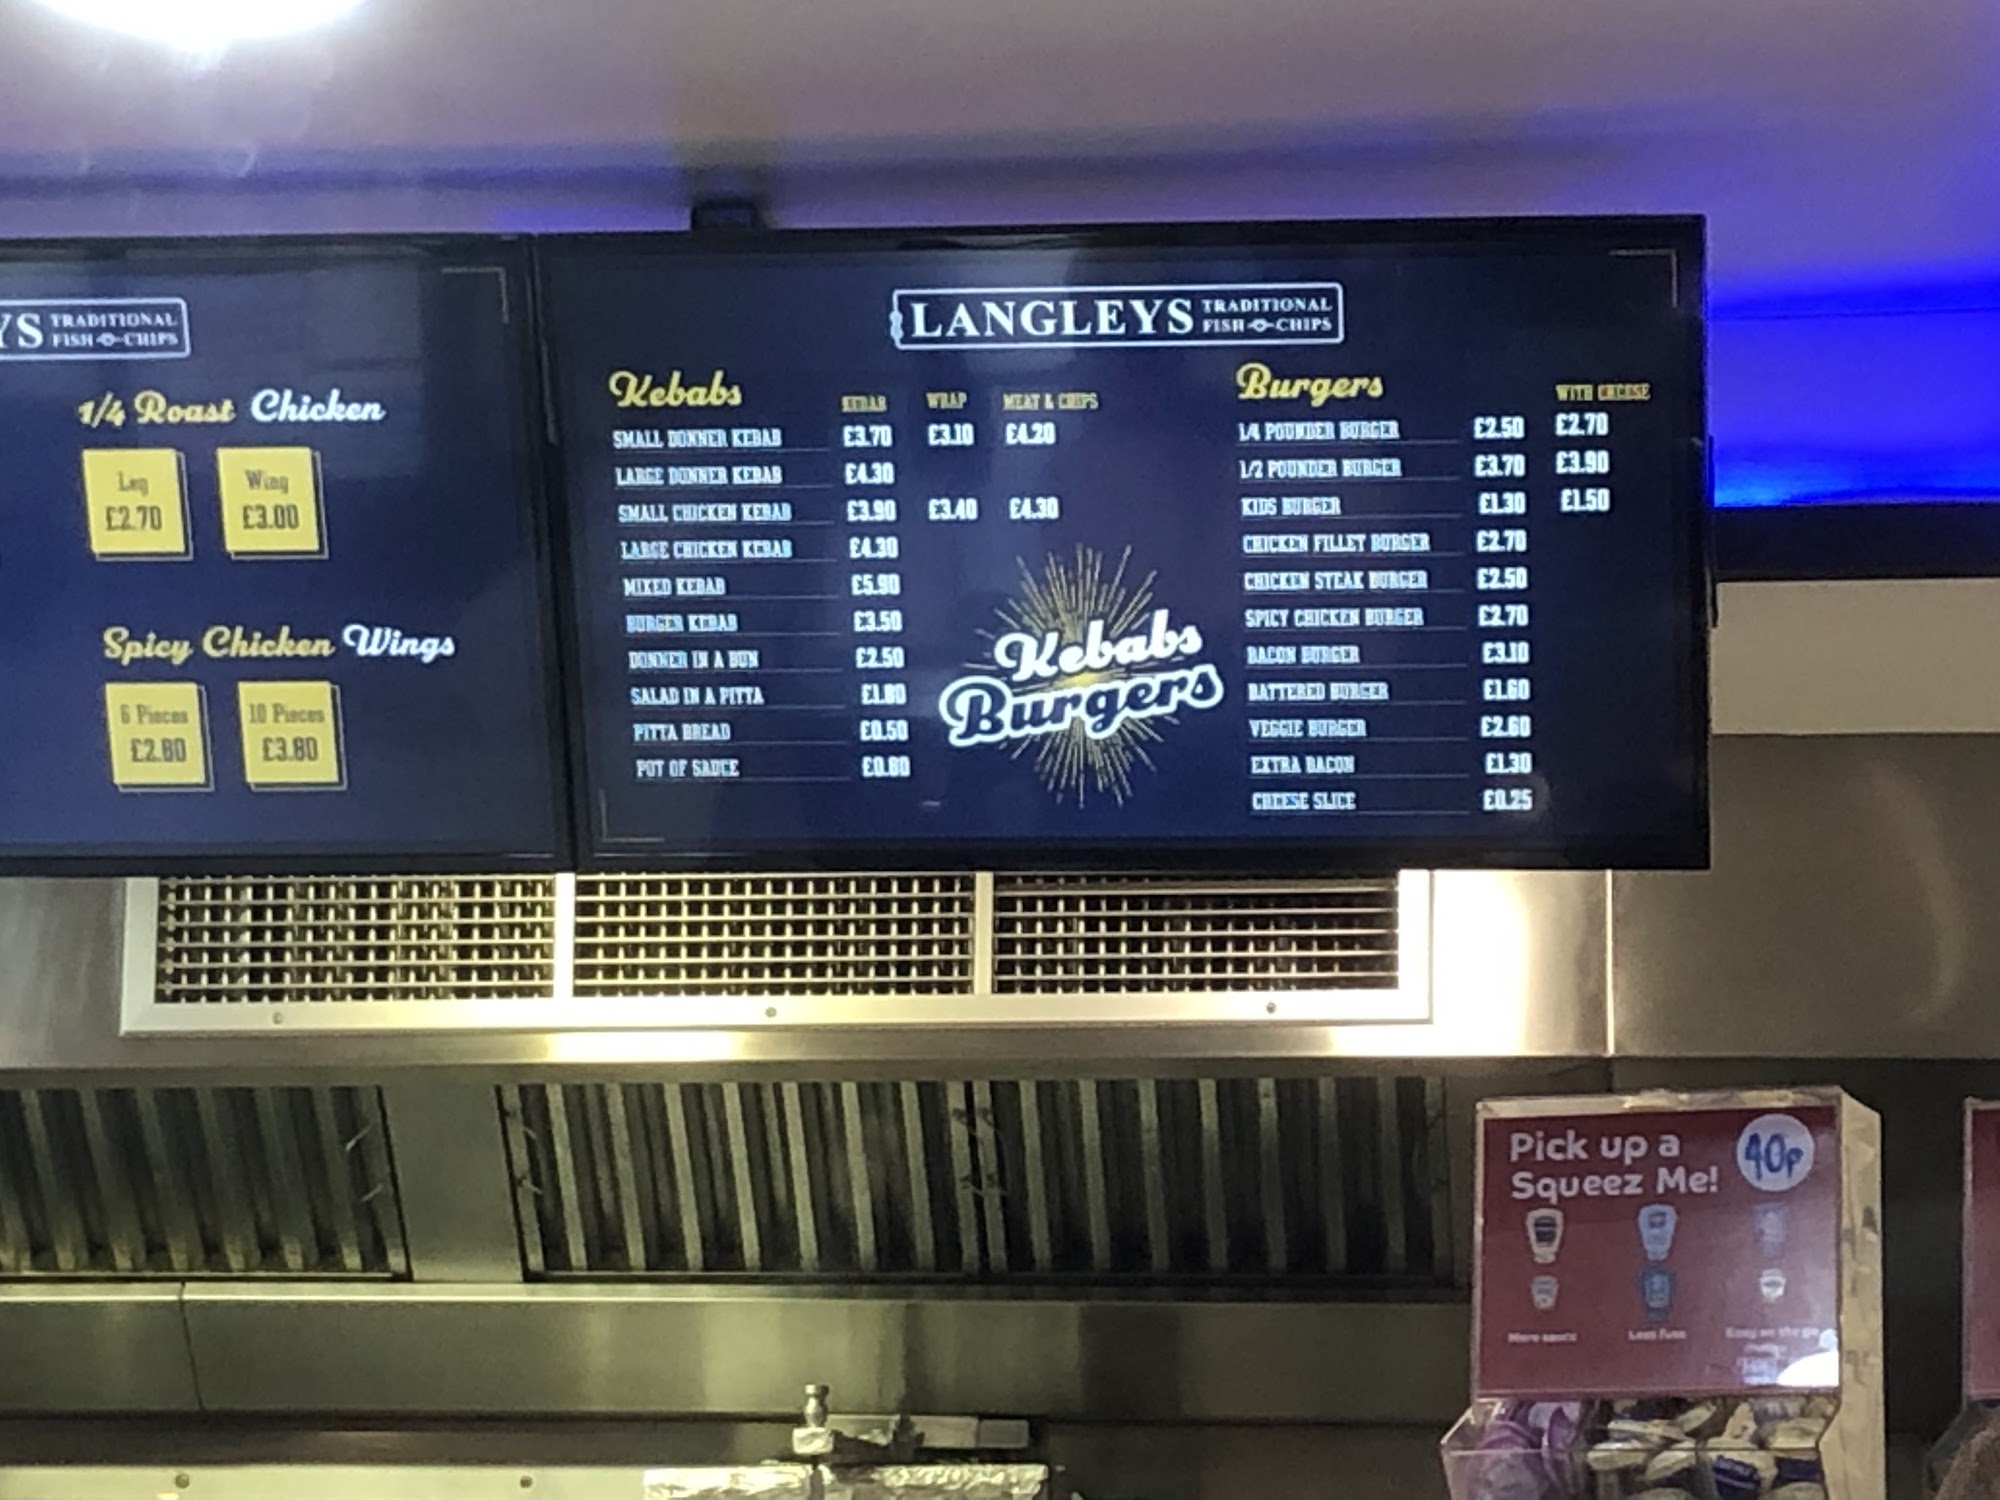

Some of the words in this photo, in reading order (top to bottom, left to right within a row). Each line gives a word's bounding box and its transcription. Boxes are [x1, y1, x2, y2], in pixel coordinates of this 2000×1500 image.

[1202, 297, 1333, 313] TRADITIONAL
[50, 311, 178, 328] TRADITIONAL
[911, 298, 1194, 338] LANGLEYS
[1202, 319, 1244, 333] FISH
[1275, 316, 1331, 331] CHIPS
[53, 332, 93, 348] FISH
[124, 331, 178, 347] CHIPS
[609, 369, 742, 408] Kebabs
[1236, 362, 1384, 407] Burgers
[1555, 384, 1593, 401] WITH
[78, 391, 126, 429] 1/4
[133, 390, 235, 424] Roast
[251, 388, 386, 422] Chicken
[926, 392, 967, 409] WRAP
[1003, 393, 1040, 411] MEAT
[1044, 393, 1054, 410] &
[1058, 392, 1099, 410] CHIPS
[613, 430, 664, 448] SMALL
[667, 430, 728, 448] DONNER
[731, 428, 782, 447] KEBAB
[843, 425, 892, 447] £3.70
[928, 423, 975, 446] £3.10
[1005, 422, 1055, 445] £4.20
[1238, 423, 1261, 441] 1/4
[1265, 422, 1335, 441] POUNDER
[1339, 421, 1399, 440] BURGER
[1473, 416, 1525, 439] £2.50
[1556, 412, 1608, 436] £2.70
[615, 467, 664, 486] LARGE
[669, 467, 728, 485] DONNER
[732, 466, 782, 485] KEBAB
[845, 462, 895, 484] £4.30
[1239, 459, 1263, 478] 1/2
[1267, 459, 1338, 478] POUNDER
[1342, 458, 1402, 477] BURGER
[1474, 454, 1526, 478] £3.70
[1556, 450, 1609, 474] £3.90
[118, 471, 149, 496] Leg
[244, 469, 289, 494] Wing
[618, 503, 668, 523] SMALL
[672, 503, 737, 522] CHICKEN
[741, 502, 792, 521] KEBAB
[847, 499, 897, 522] £3.90
[929, 498, 978, 520] £3.40
[1009, 497, 1059, 520] £4.30
[1241, 498, 1277, 516] KIDS
[1281, 497, 1342, 515] BURGER
[1479, 491, 1526, 515] £1.30
[1561, 488, 1611, 512] £1.50
[105, 506, 162, 531] £2.70
[243, 504, 300, 529] £3.00
[620, 541, 669, 560] LARGE
[673, 540, 737, 558] CHICKEN
[742, 540, 792, 558] KEBAB
[850, 536, 899, 558] £4.30
[1242, 534, 1308, 553] CHICKEN
[1313, 534, 1366, 552] FILLET
[1370, 533, 1430, 552] BURGER
[1476, 529, 1527, 553] £2.70
[623, 578, 672, 596] MIXED
[675, 577, 726, 596] KEBAB
[852, 573, 900, 596] £5.90
[1244, 572, 1309, 590] CHICKEN
[1315, 571, 1364, 590] STEAK
[1368, 570, 1428, 589] BURGER
[1476, 567, 1528, 590] £2.50
[626, 614, 684, 633] BURGER
[688, 614, 738, 632] KEBAB
[854, 610, 903, 632] £3.50
[1244, 609, 1289, 628] SPICY
[1293, 608, 1360, 627] CHICKEN
[1364, 607, 1424, 626] BURGER
[1478, 604, 1529, 627] £2.70
[103, 627, 193, 666] Spicy
[203, 625, 335, 658] Chicken
[342, 624, 455, 664] Wings
[994, 609, 1203, 682] Kebabs
[1246, 645, 1297, 664] BACON
[1301, 645, 1360, 664] BURGER
[1482, 641, 1530, 664] £3.10
[628, 651, 688, 669] DONNER
[692, 650, 709, 668] IN
[713, 650, 725, 668] A
[728, 650, 759, 668] BUN
[856, 647, 904, 669] £2.50
[631, 687, 680, 705] SALAD
[683, 687, 700, 705] IN
[704, 687, 716, 705] A
[719, 686, 765, 705] PITTA
[1248, 683, 1325, 701] BATTERED
[1329, 682, 1389, 701] BURGER
[1483, 678, 1531, 701] £1.60
[120, 705, 130, 724] 6
[137, 704, 188, 724] Pieces
[249, 703, 267, 723] 10
[273, 703, 325, 724] Pieces
[940, 664, 1224, 747] Burgers
[633, 724, 678, 742] PITTA
[682, 723, 731, 741] BREAD
[860, 720, 909, 741] £0.50
[1248, 719, 1303, 738] VEGGIE
[1307, 719, 1367, 737] BURGER
[1480, 715, 1531, 738] £2.60
[131, 738, 187, 763] £2.80
[263, 736, 318, 762] £3.80
[636, 759, 664, 778] POT
[669, 759, 688, 777] OF
[692, 759, 740, 777] SAUCE
[1251, 755, 1301, 774] EXTRA
[1305, 755, 1355, 774] BACON
[1485, 752, 1532, 775] £1.30
[1252, 792, 1309, 811] CHEESE
[1312, 791, 1356, 810] SLICE
[1483, 789, 1533, 811] £0.25
[1510, 1129, 1589, 1162] Pick
[1600, 1134, 1649, 1165] up
[1658, 1134, 1680, 1157] a
[1511, 1171, 1644, 1205] Squeez
[1656, 1165, 1719, 1194] Me!
